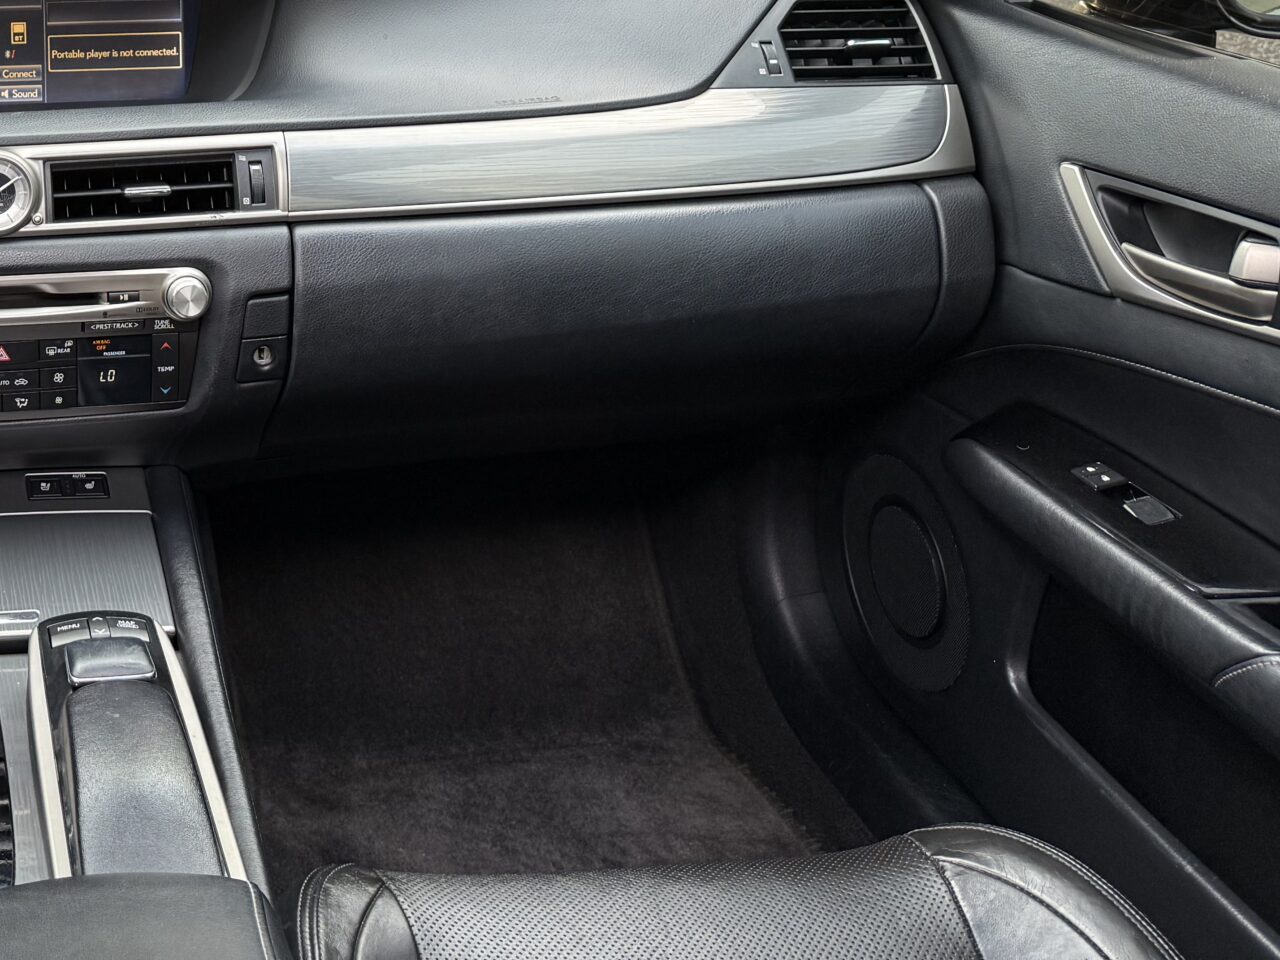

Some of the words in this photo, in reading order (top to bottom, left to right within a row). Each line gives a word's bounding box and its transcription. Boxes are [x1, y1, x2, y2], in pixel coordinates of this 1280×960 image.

[51, 50, 85, 59] Portable
[86, 49, 111, 60] player
[112, 48, 119, 57] is
[120, 48, 133, 57] not
[135, 47, 179, 56] connected.
[2, 69, 37, 78] Connect
[12, 89, 38, 99] Sound
[99, 369, 116, 382] LO
[57, 623, 80, 632] MENU
